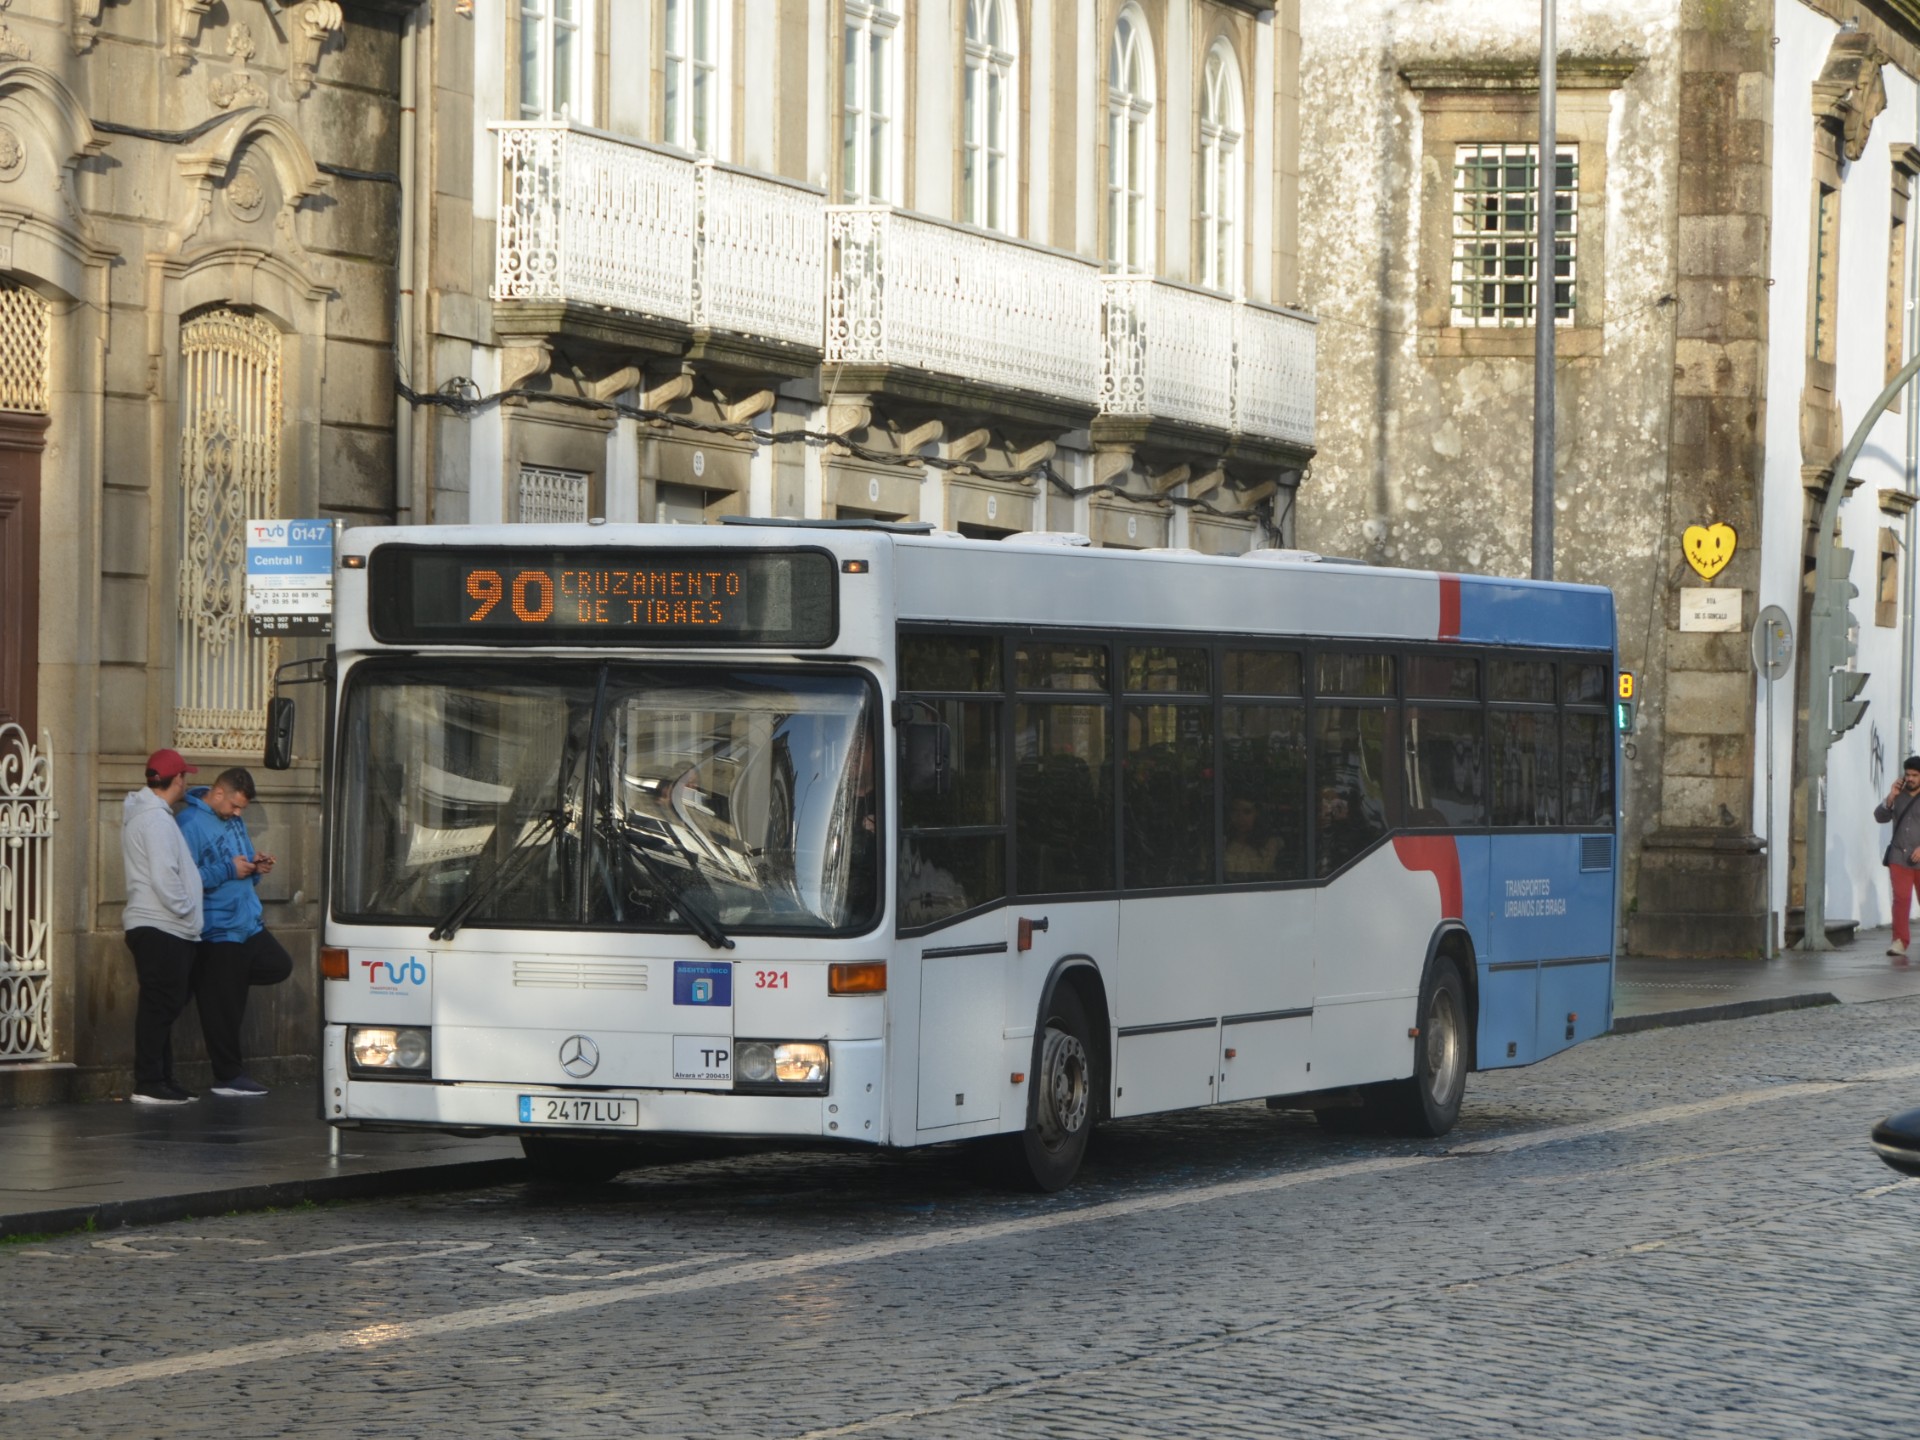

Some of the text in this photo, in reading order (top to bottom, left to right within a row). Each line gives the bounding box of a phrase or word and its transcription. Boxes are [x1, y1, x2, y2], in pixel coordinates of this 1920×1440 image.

[292, 527, 326, 541] 0147
[254, 555, 303, 566] Central II
[560, 570, 740, 596] CRUZAMENTO
[466, 569, 554, 622] 90
[577, 599, 609, 623] DE
[1619, 674, 1633, 698] 8
[1505, 878, 1550, 897] TRANSPORTES
[1504, 898, 1566, 918] URBANOS DE BRAGA
[676, 966, 705, 974] AGENTE
[755, 970, 789, 989] 321
[701, 1049, 729, 1068] TP
[547, 1100, 621, 1122] 2417LU
